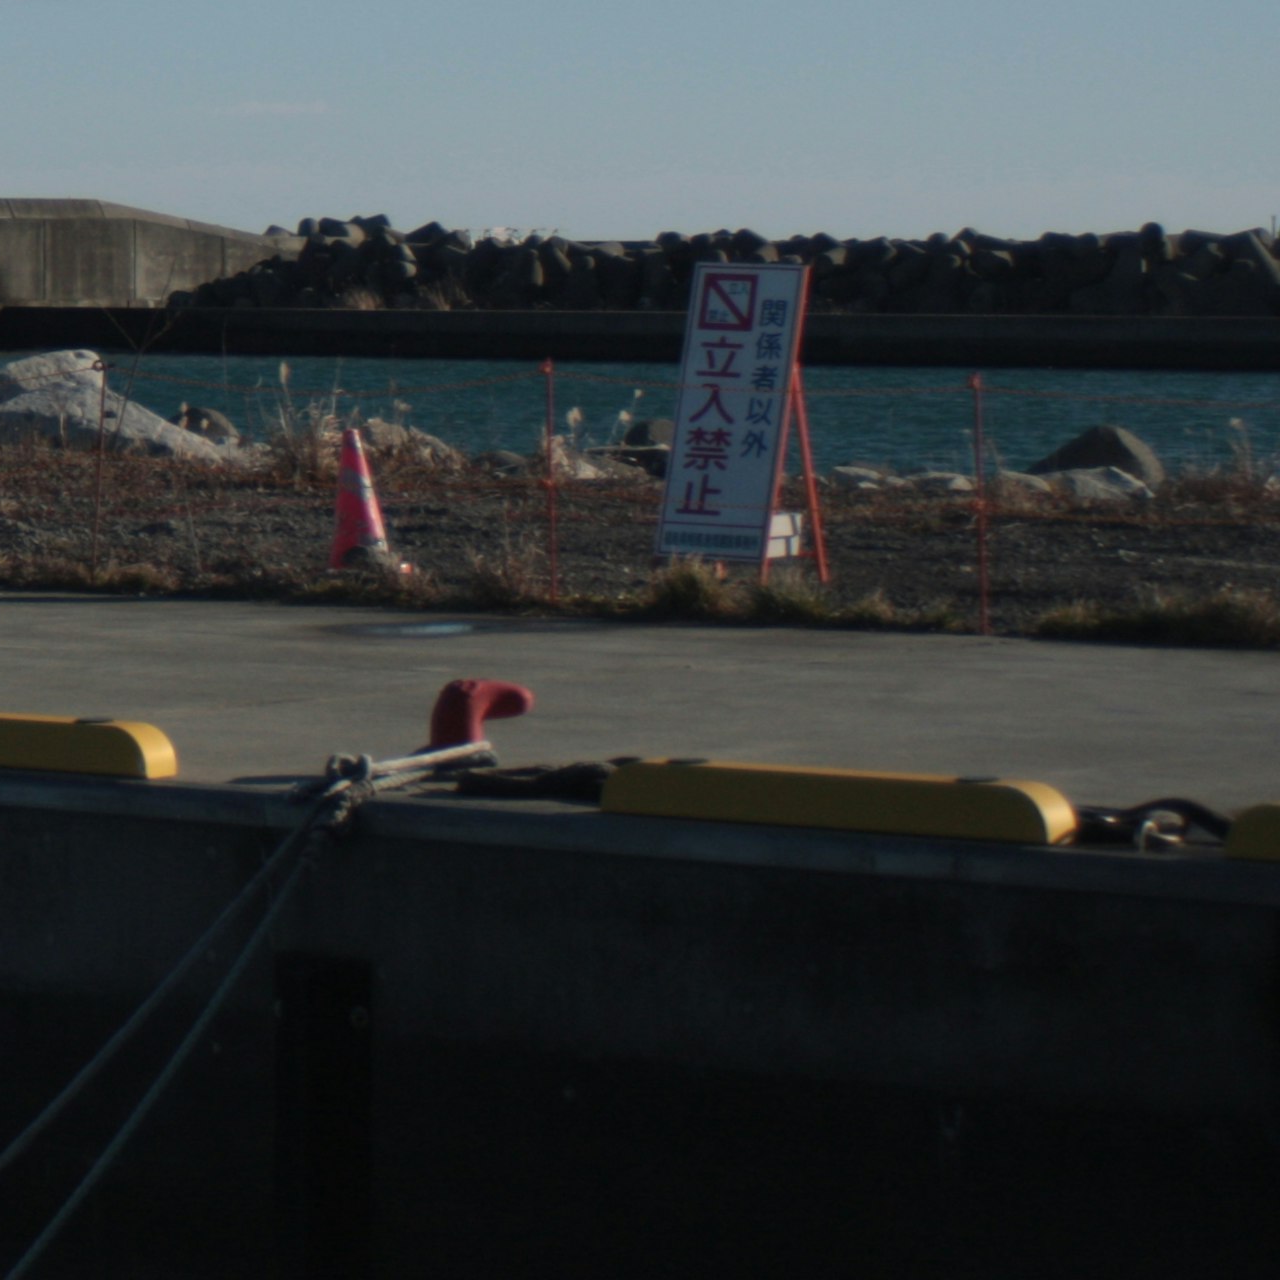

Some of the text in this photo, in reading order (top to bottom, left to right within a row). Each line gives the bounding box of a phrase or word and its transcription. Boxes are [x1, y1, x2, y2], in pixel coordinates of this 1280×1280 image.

[675, 336, 744, 516] 立入禁止
[739, 298, 788, 459] 関係者以外
